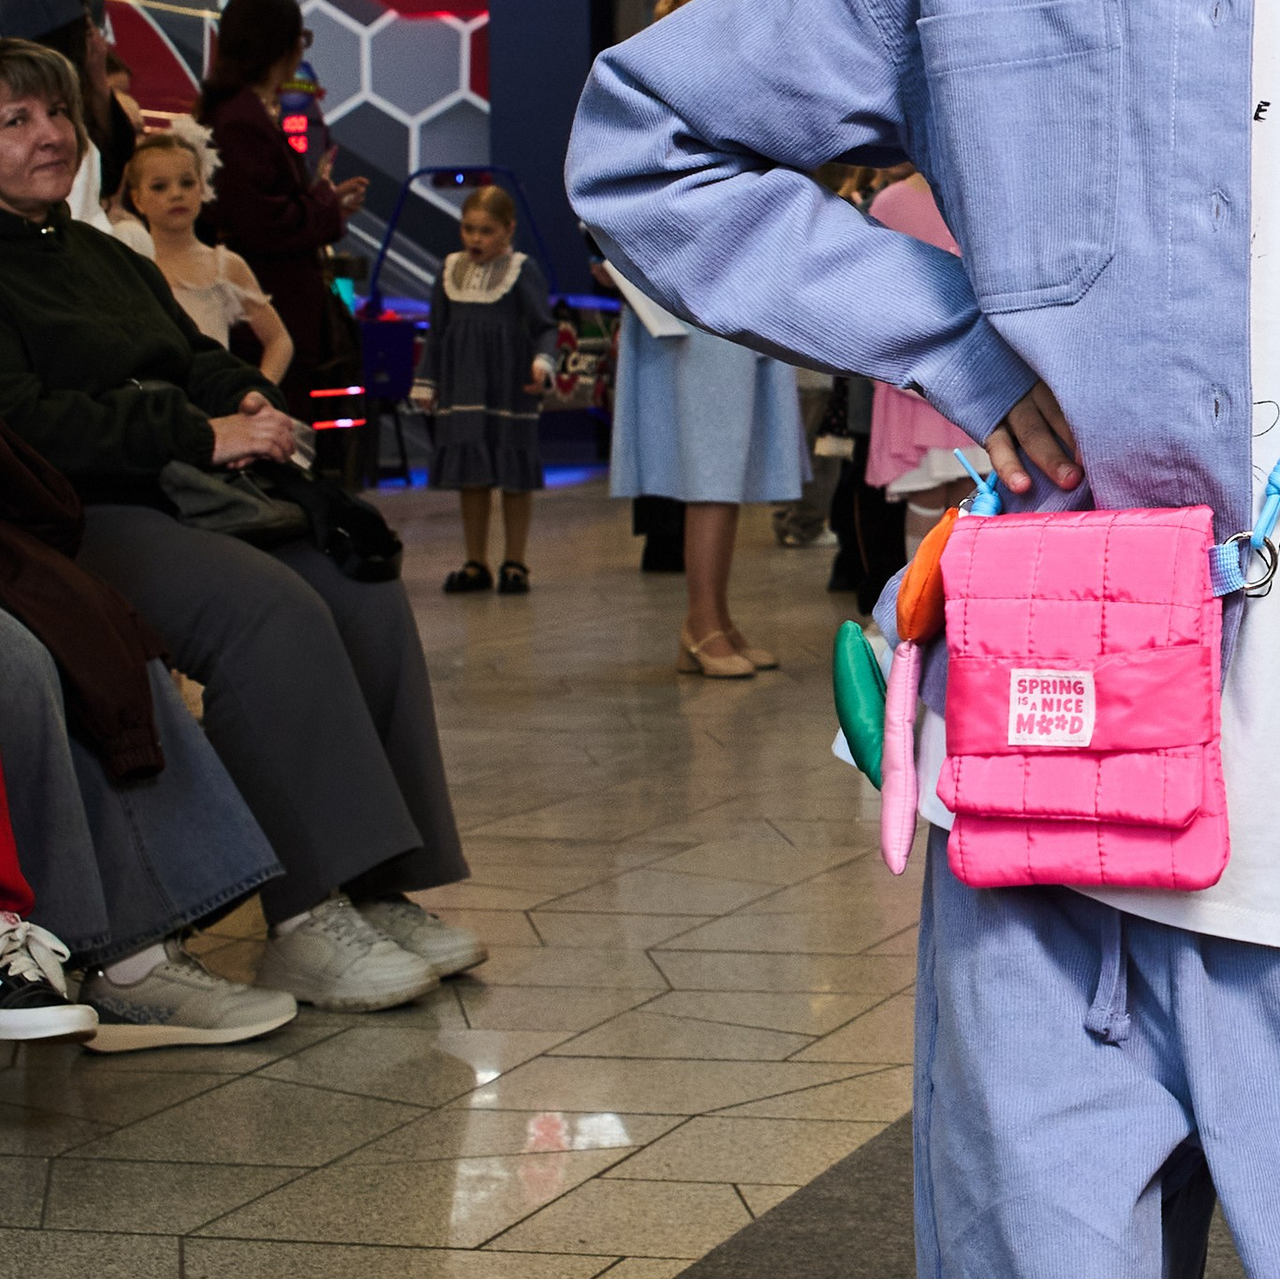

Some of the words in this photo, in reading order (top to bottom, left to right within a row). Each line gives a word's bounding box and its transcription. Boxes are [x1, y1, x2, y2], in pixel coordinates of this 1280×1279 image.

[1017, 678, 1085, 696] SPRING
[1018, 696, 1029, 706] IS
[1030, 702, 1038, 712] A
[1041, 697, 1084, 714] NICE
